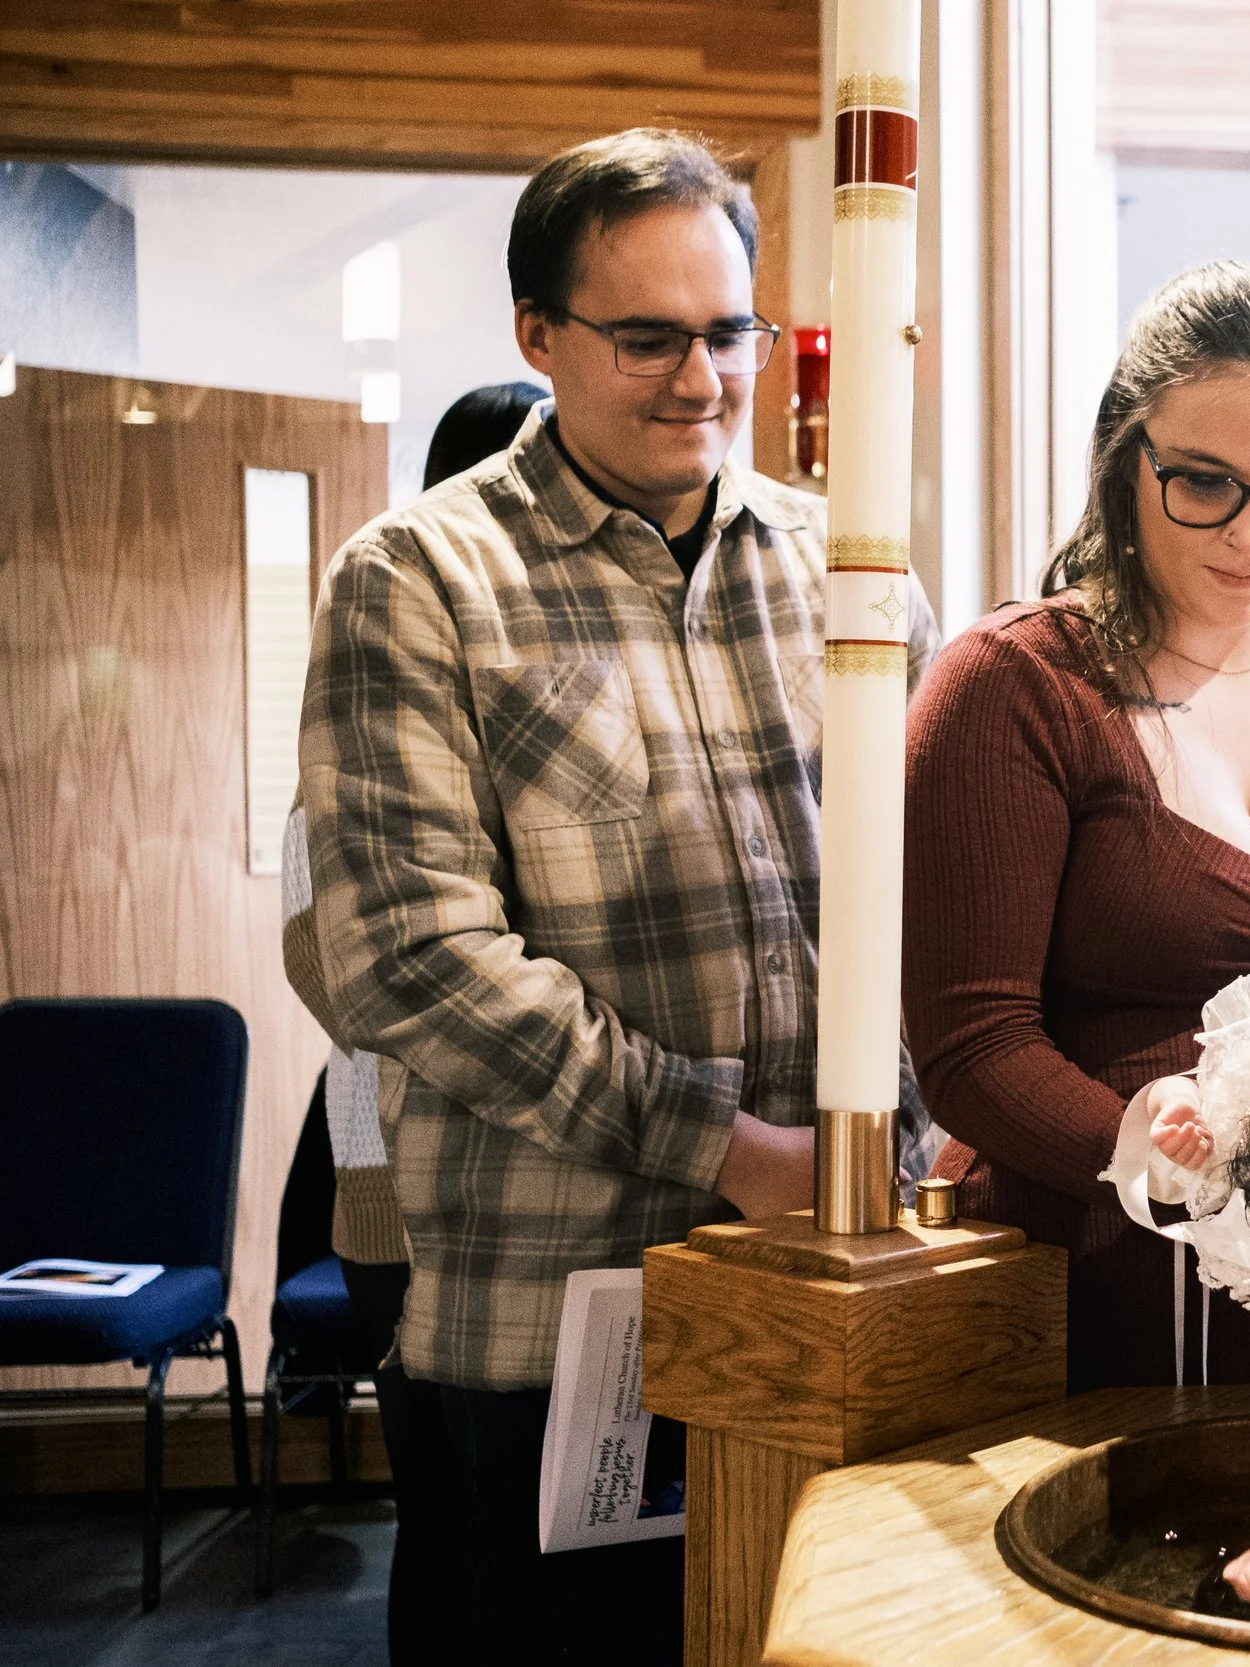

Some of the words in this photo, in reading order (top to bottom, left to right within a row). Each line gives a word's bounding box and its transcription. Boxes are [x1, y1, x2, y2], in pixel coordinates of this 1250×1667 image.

[624, 1316, 636, 1339] Hope
[624, 1341, 631, 1351] of
[618, 1353, 630, 1384] Church
[611, 1386, 625, 1424] Lutheran
